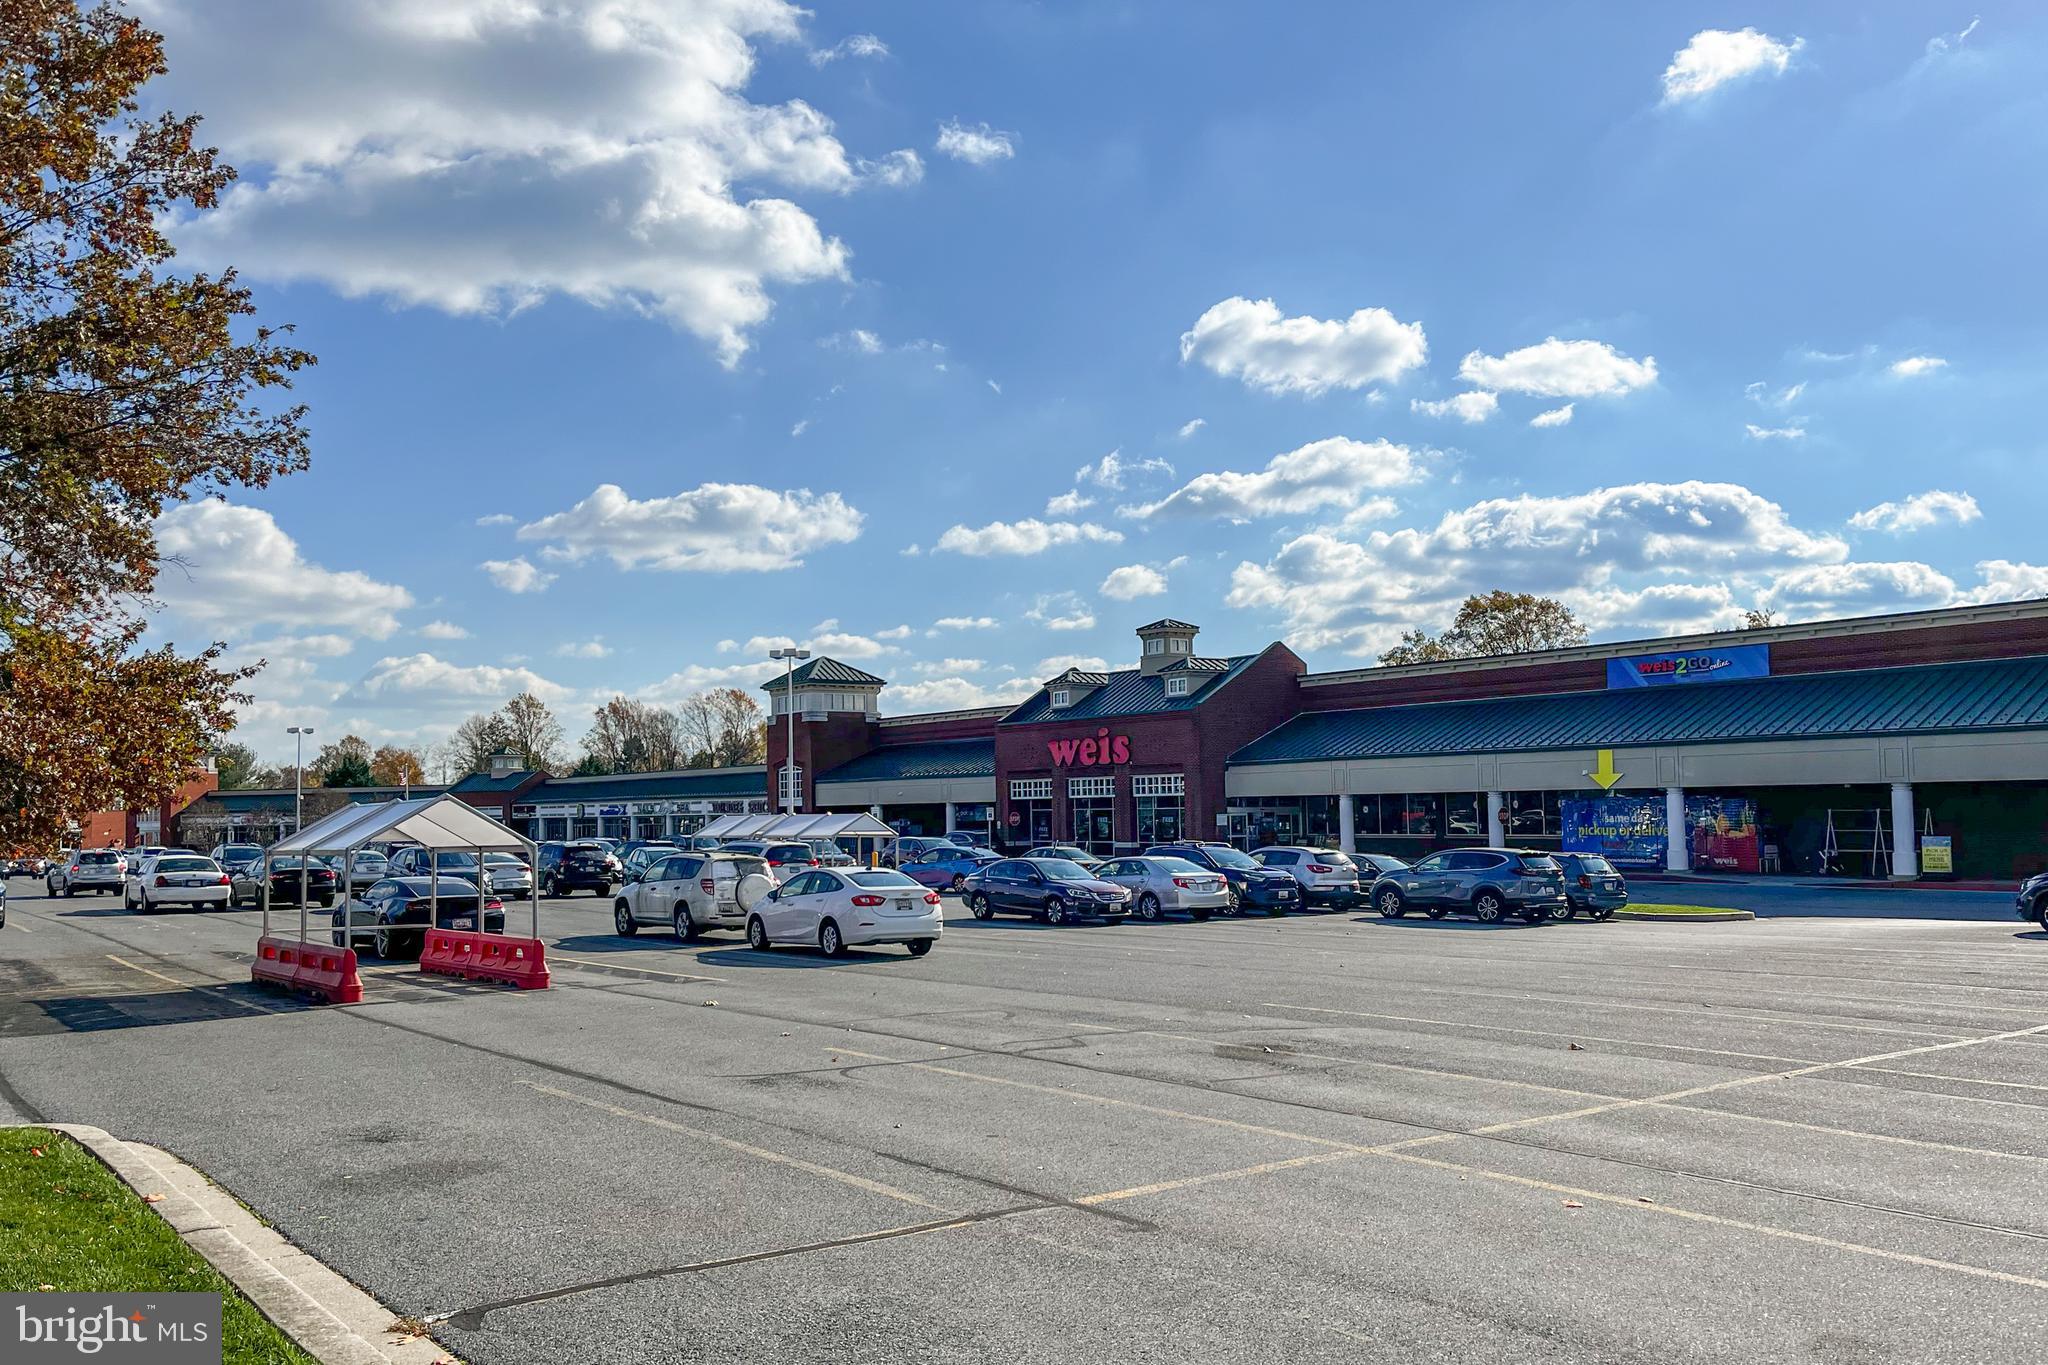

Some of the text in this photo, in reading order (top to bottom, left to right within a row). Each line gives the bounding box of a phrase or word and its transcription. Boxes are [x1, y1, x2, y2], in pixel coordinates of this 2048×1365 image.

[1047, 727, 1130, 767] weis
[1604, 815, 1630, 823] same
[1578, 821, 1668, 838] pickup or delive
[1713, 856, 1739, 865] weis
